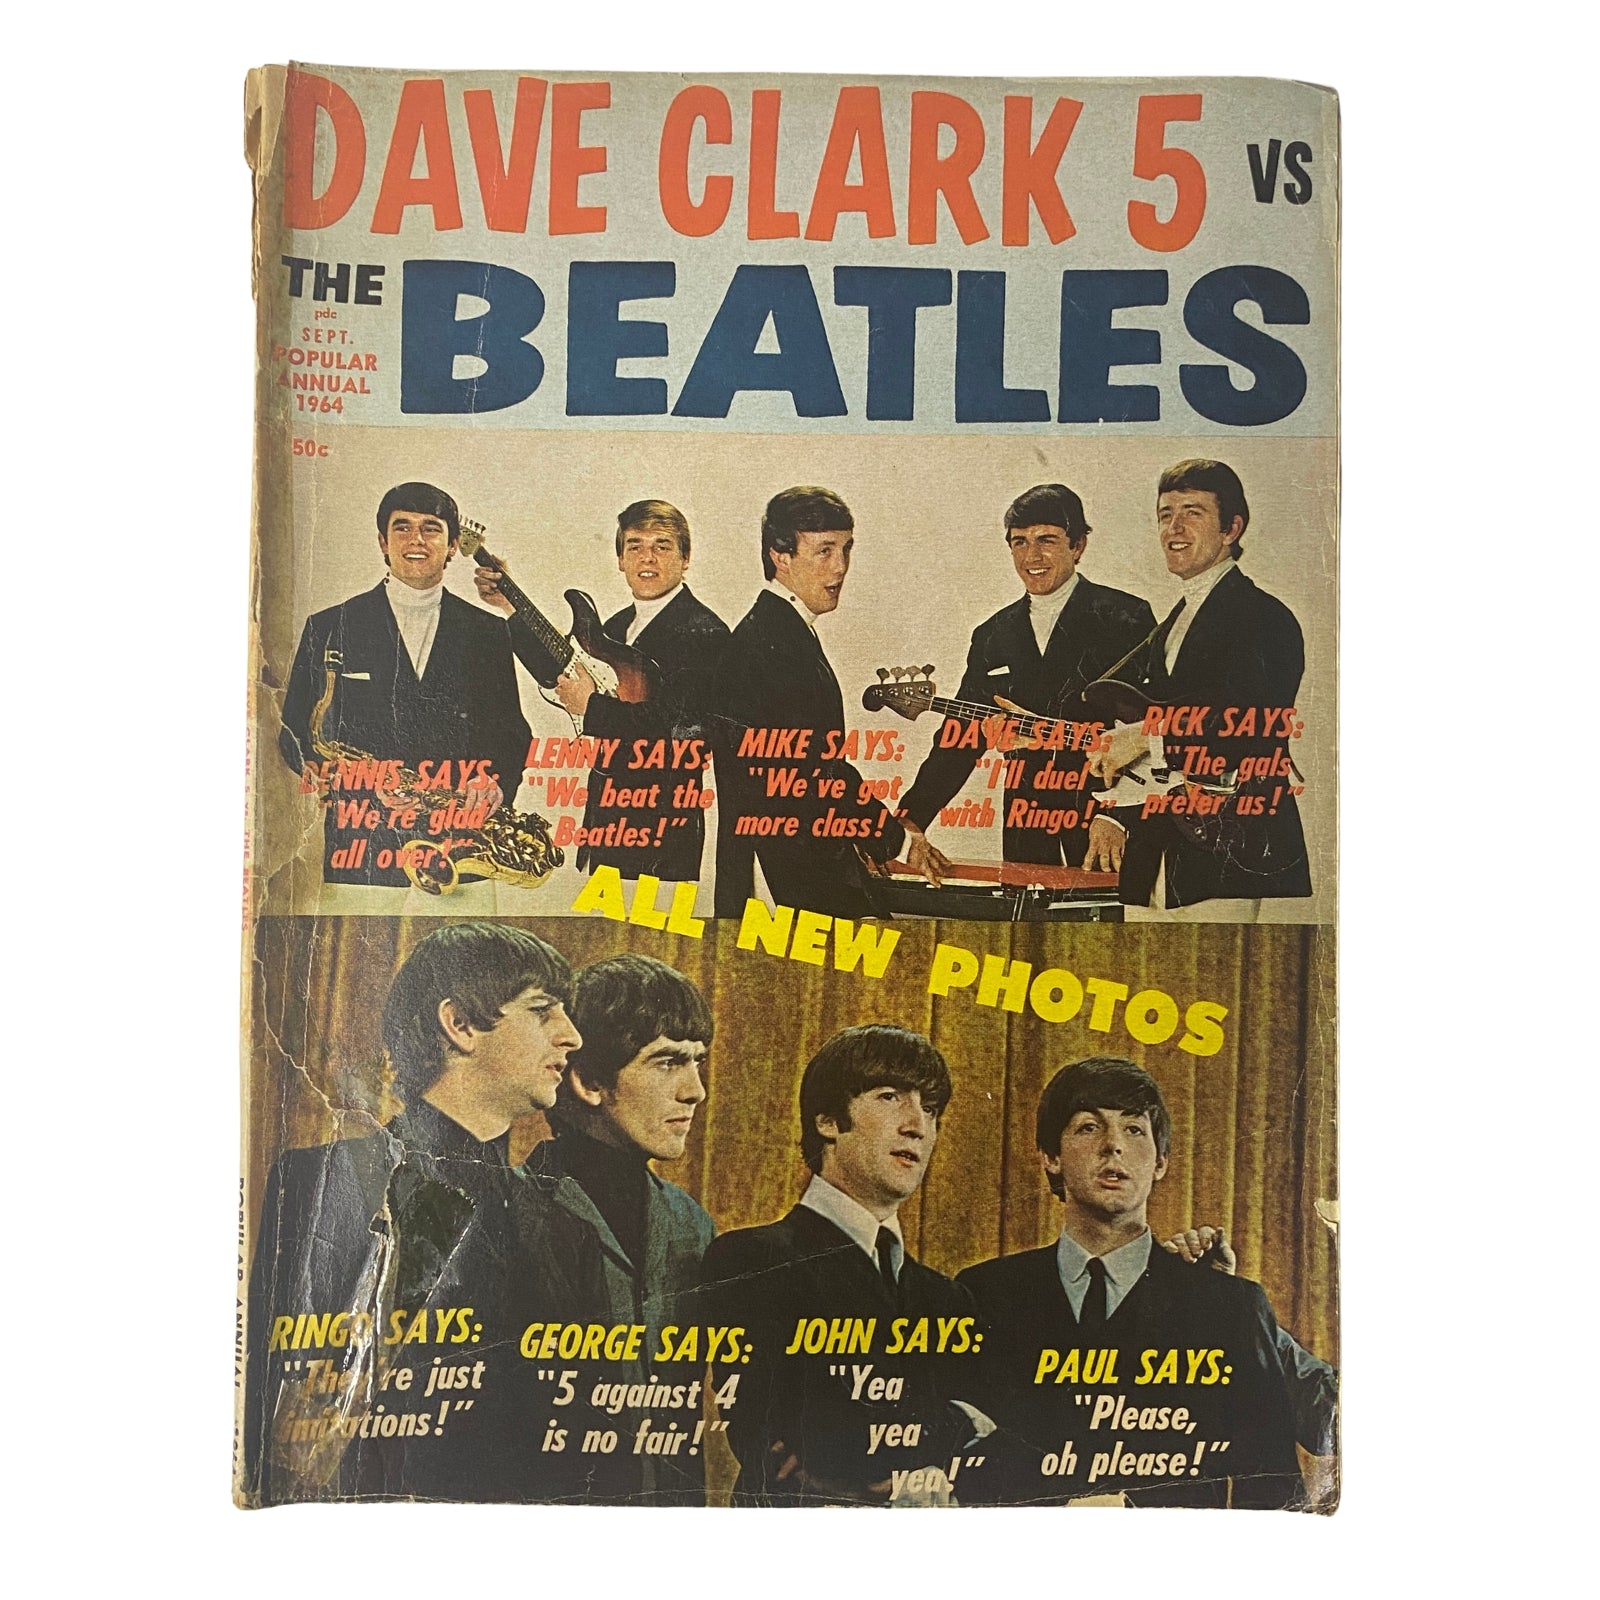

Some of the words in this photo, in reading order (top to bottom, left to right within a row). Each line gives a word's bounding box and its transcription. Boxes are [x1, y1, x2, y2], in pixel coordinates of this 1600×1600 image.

[284, 68, 611, 235] DAVE
[659, 85, 1083, 246] CLARK
[1128, 94, 1207, 252] 5
[1247, 139, 1313, 205] VS
[314, 307, 337, 320] pdc
[281, 255, 385, 305] THE
[401, 260, 1310, 426] BEATLES
[302, 327, 354, 344] SEPT.
[271, 345, 378, 371] POPULAR
[276, 369, 371, 394] ANNUAL
[296, 394, 344, 413] 1964
[292, 438, 329, 457] 50c
[940, 720, 1019, 750] DAVE
[1028, 721, 1113, 753] SAYS:
[1142, 706, 1210, 736] RICK
[1218, 707, 1304, 739] SAYS:
[526, 738, 615, 769] LENNY
[627, 739, 713, 771] SAYS:
[738, 728, 811, 758] MIKE
[821, 730, 905, 762] SAYS:
[300, 760, 404, 794] DENNIS
[415, 759, 500, 791] SAYS:
[1033, 760, 1090, 791] duel
[1165, 745, 1228, 776] "The
[1237, 748, 1291, 782] gals
[528, 776, 588, 808] "We
[601, 778, 664, 809] beat
[672, 777, 715, 810] the
[749, 768, 846, 799] "We've
[859, 774, 903, 804] got
[1141, 792, 1225, 820] prefer
[1237, 787, 1304, 816] us!"
[429, 799, 490, 836] glad
[554, 816, 689, 848] Beatles!"
[736, 815, 799, 837] more
[812, 808, 908, 839] class!"
[940, 800, 996, 829] with
[331, 839, 367, 869] all
[572, 864, 705, 939] ALL
[737, 898, 902, 980] NEW
[928, 943, 1230, 1057] PHOTOS
[269, 1312, 372, 1352] RINGO
[384, 1307, 483, 1345] SAYS:
[521, 1323, 642, 1361] GEORGE
[654, 1326, 754, 1364] SAYS:
[786, 1318, 877, 1355] JOHN
[886, 1316, 984, 1354] SAYS:
[424, 1356, 486, 1398] just
[828, 1364, 904, 1401] "Yea
[1034, 1349, 1120, 1385] PAUL
[1134, 1349, 1233, 1385] SAYS:
[590, 1376, 702, 1415] against
[714, 1372, 742, 1410] 4
[1074, 1395, 1198, 1435] "Please,
[541, 1419, 566, 1454] is
[582, 1428, 618, 1454] no
[867, 1420, 921, 1455] yea
[1042, 1441, 1075, 1476] oh
[1088, 1440, 1230, 1483] please!"
